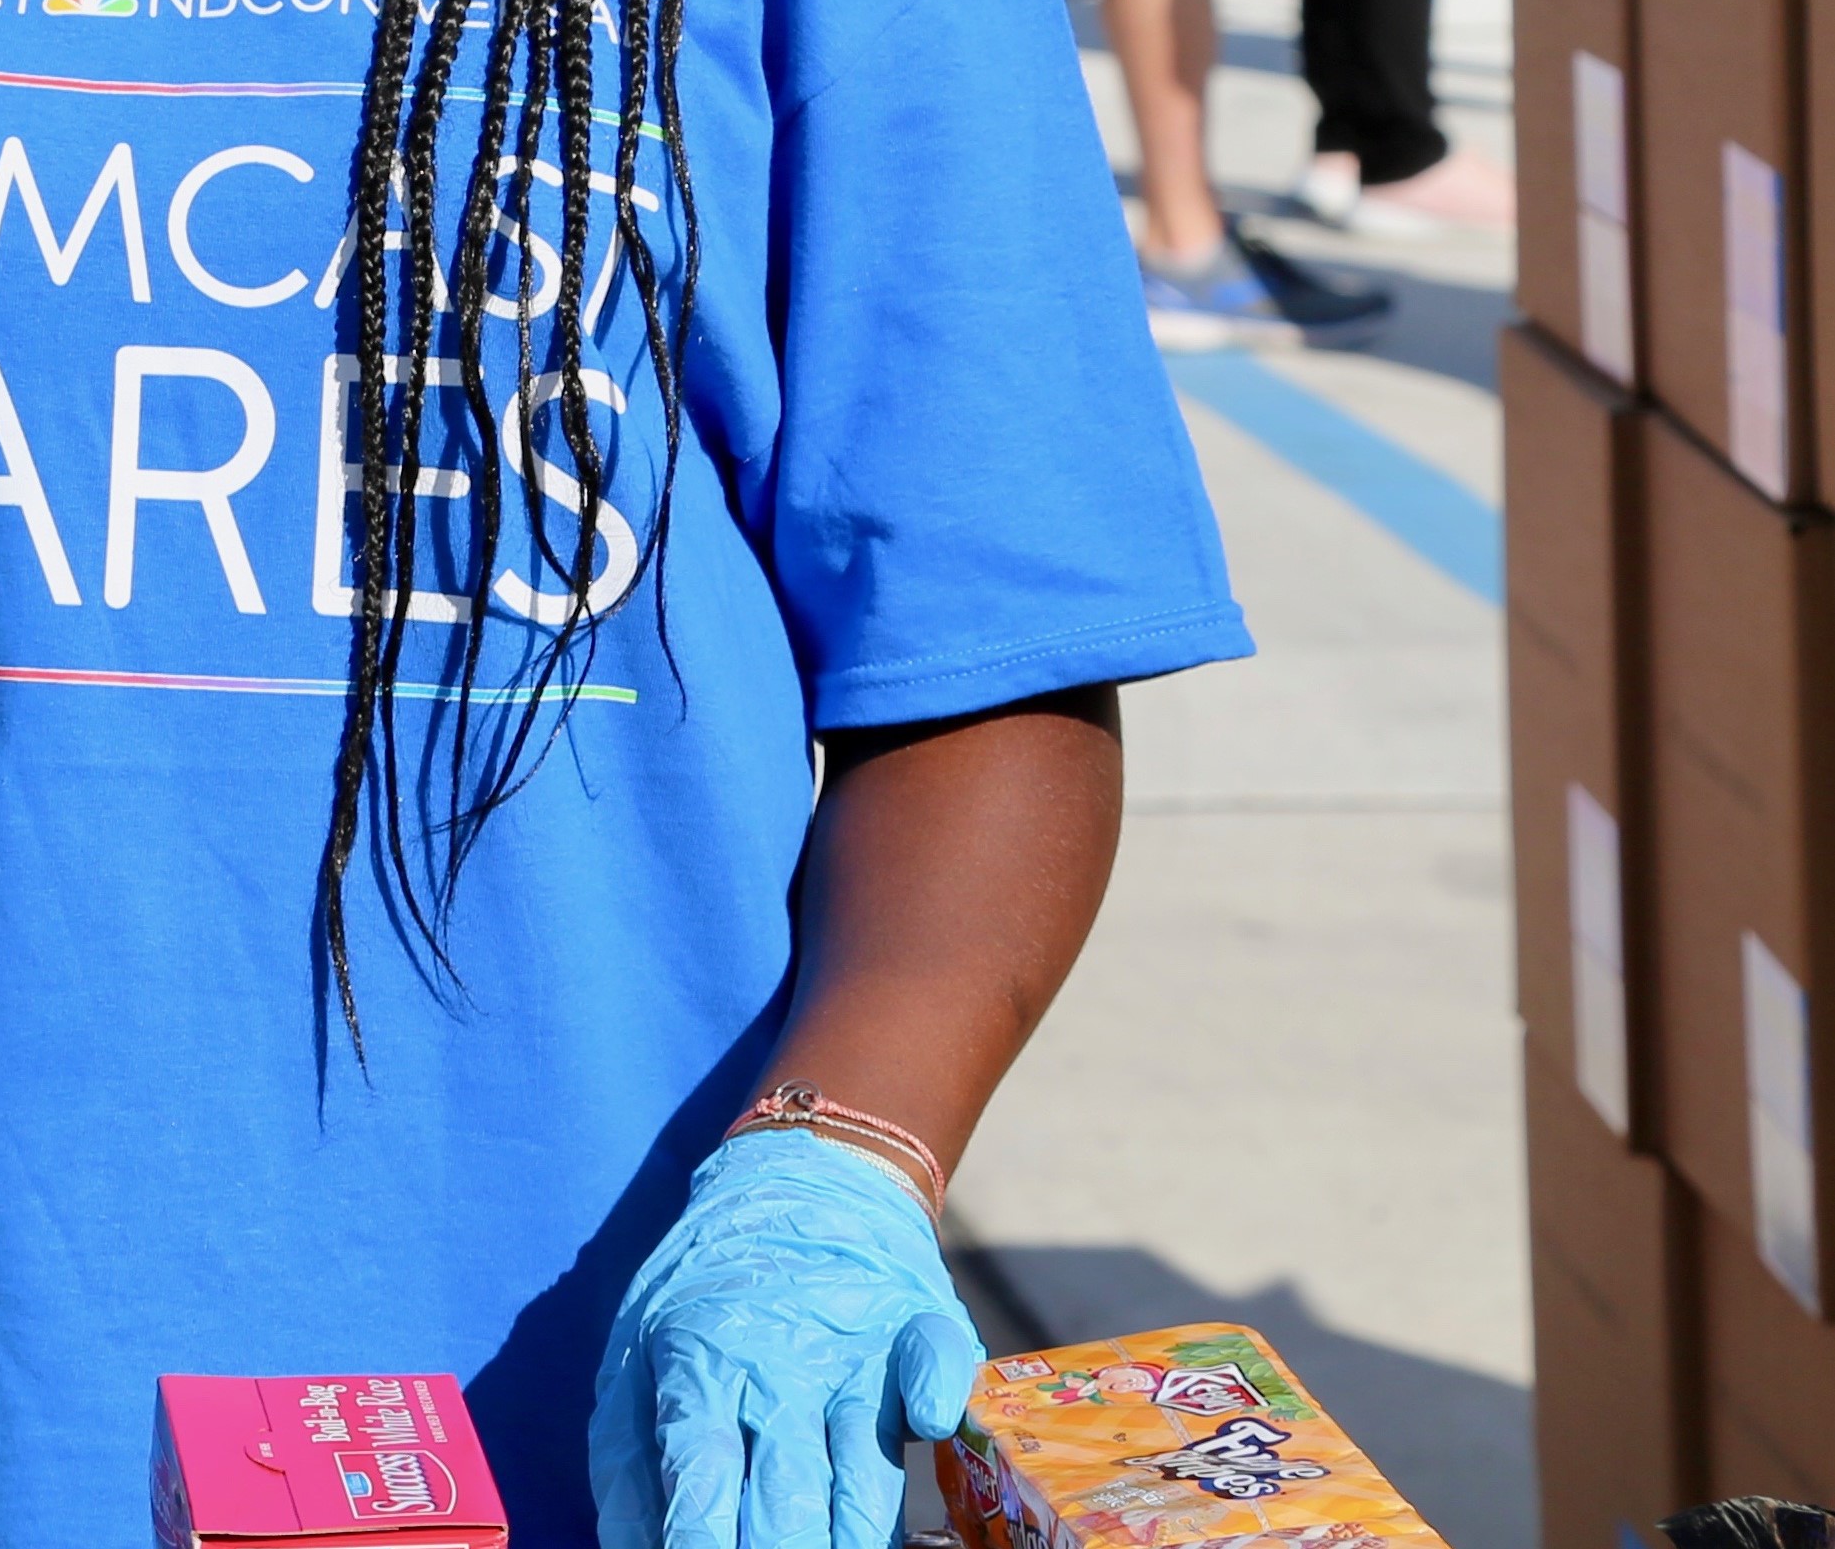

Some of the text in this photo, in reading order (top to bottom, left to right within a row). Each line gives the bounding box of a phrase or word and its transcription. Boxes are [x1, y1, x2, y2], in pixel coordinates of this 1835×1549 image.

[299, 1384, 352, 1443] Boil-in-Bag
[356, 1379, 421, 1447] White Rice
[371, 1453, 437, 1513] Success
